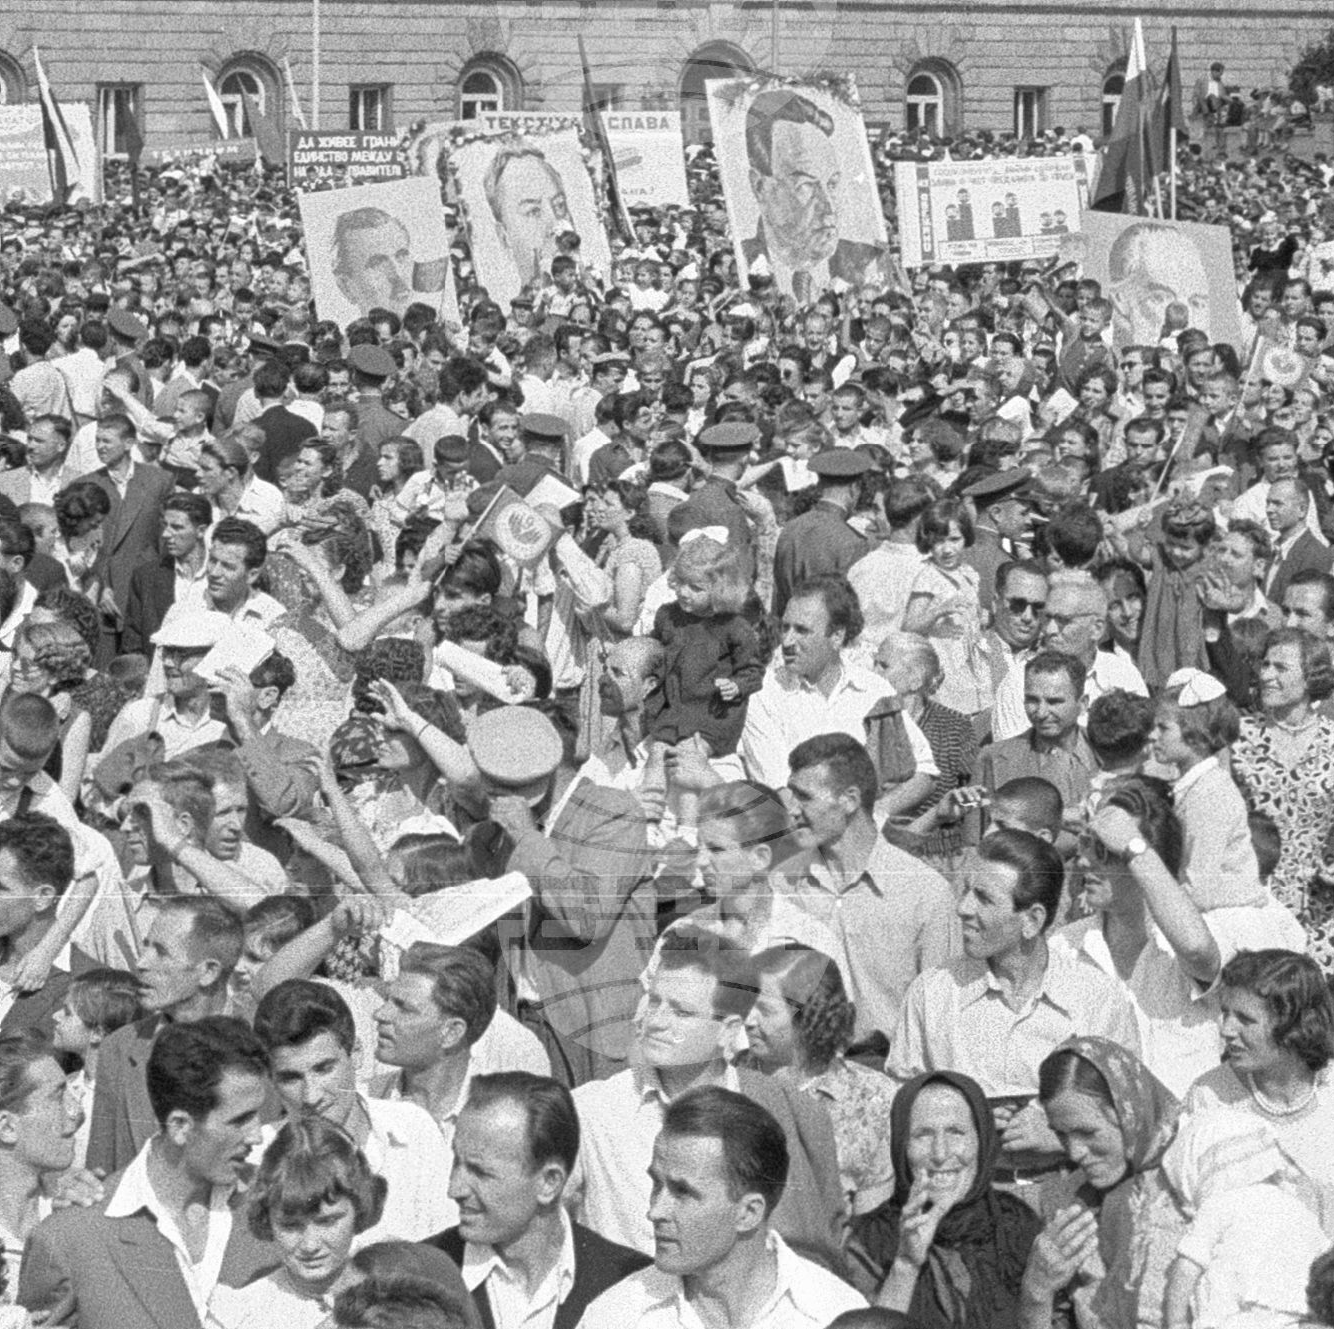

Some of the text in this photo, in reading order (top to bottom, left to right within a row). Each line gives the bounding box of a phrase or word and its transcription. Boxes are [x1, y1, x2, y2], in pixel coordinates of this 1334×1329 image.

[297, 136, 315, 149] ДА
[318, 135, 357, 148] ЖИВЕЕ
[294, 151, 348, 163] ЕДИНСТВО
[351, 151, 393, 163] МЕЖДУ
[294, 165, 333, 178] НАДА
